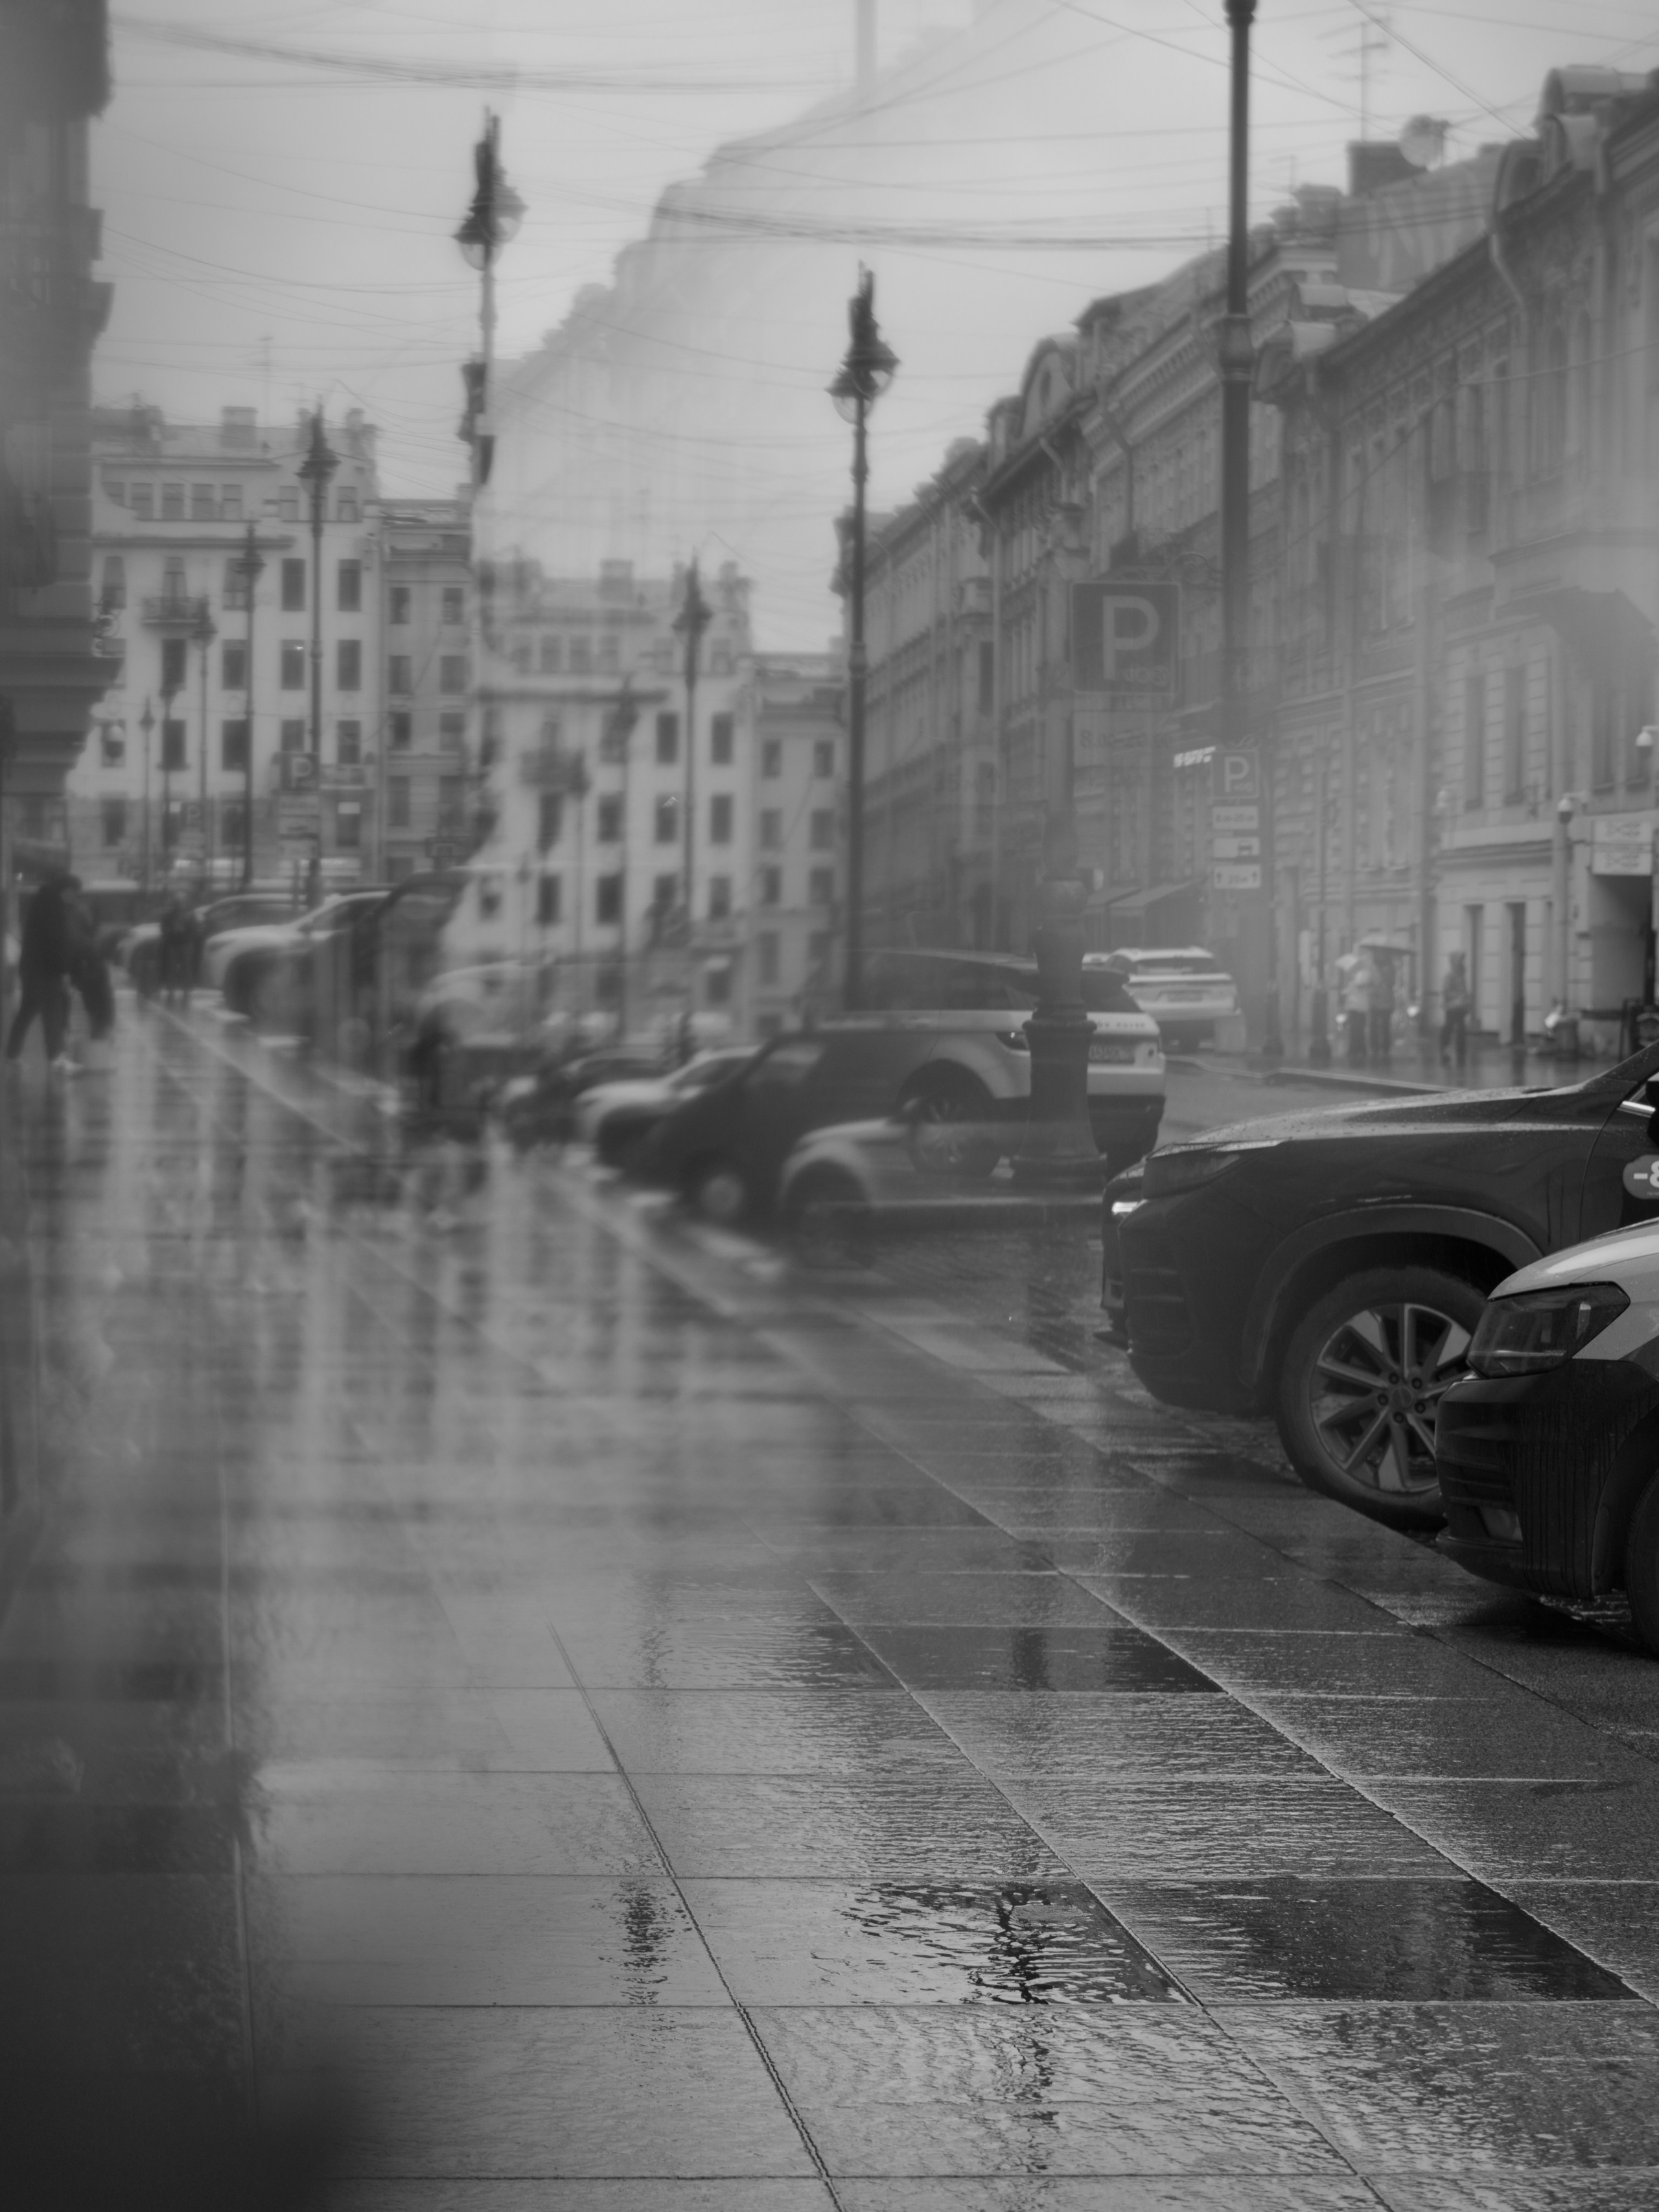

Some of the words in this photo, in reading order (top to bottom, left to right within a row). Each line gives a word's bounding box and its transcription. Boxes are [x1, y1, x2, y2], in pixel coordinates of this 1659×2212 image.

[1102, 595, 1161, 681] P
[291, 757, 312, 788] P
[1224, 756, 1251, 793] P
